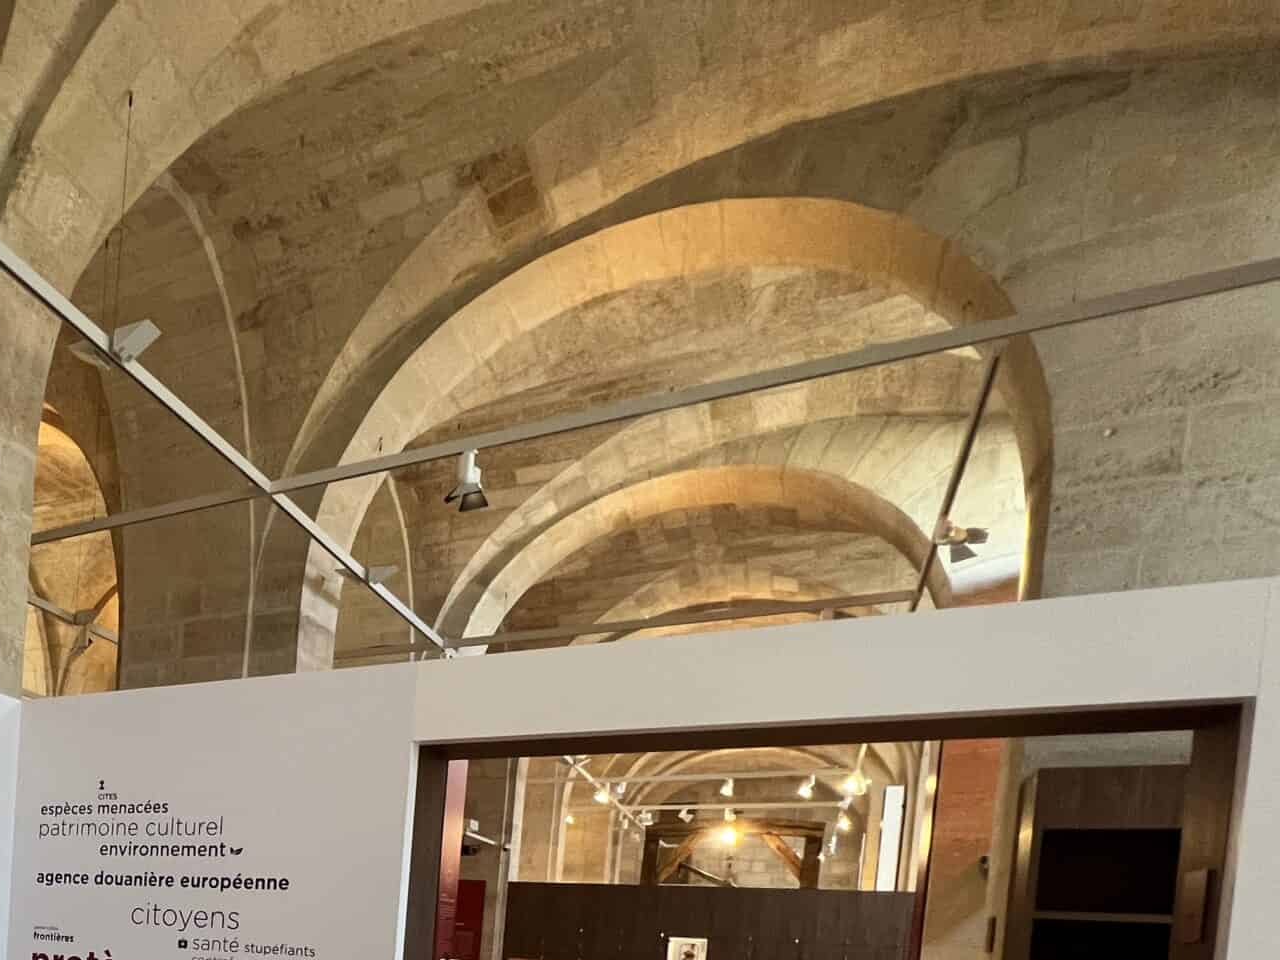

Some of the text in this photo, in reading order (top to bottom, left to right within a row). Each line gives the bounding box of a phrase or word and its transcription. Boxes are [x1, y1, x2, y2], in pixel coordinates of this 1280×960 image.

[40, 800, 168, 816] espèces menacées
[38, 816, 224, 839] patrimoine culturel
[100, 842, 226, 858] environnement
[36, 870, 289, 892] agence douanière européenne
[130, 901, 240, 931] citoyens
[34, 931, 74, 942] frontières
[192, 935, 316, 958] santé stupéfiants
